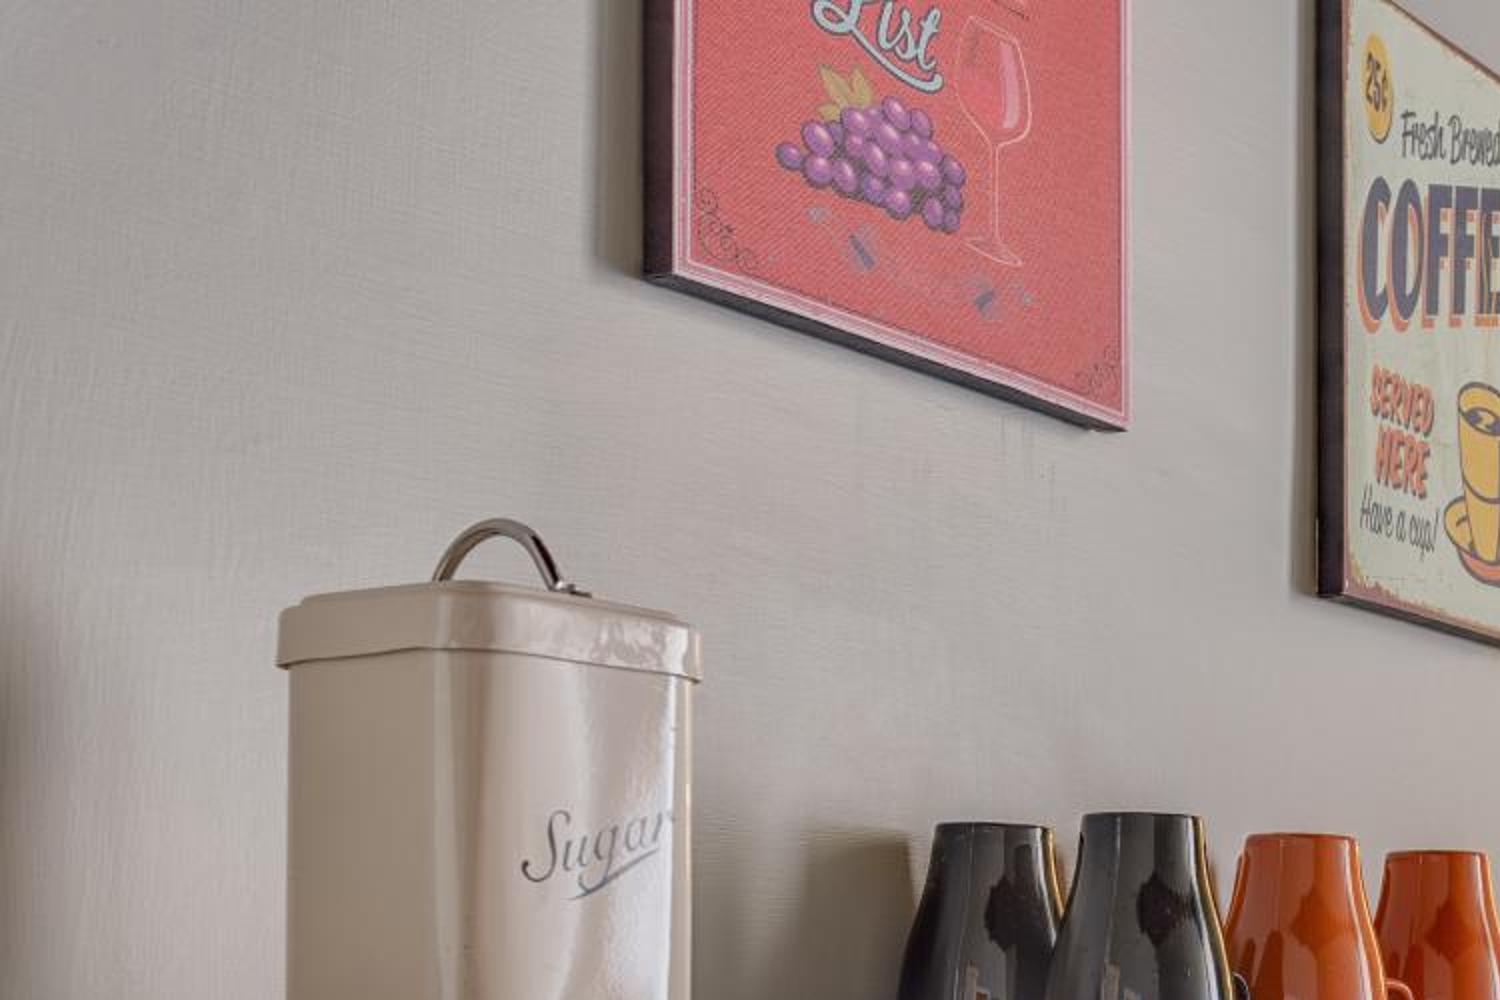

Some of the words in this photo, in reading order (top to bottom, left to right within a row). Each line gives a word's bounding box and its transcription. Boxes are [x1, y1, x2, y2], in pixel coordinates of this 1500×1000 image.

[1400, 109, 1447, 161] Fresh
[1370, 363, 1435, 437] SERVED
[1374, 423, 1431, 500] HERE
[1359, 482, 1393, 538] Have
[1396, 511, 1407, 543] a
[1409, 508, 1439, 562] cup!
[521, 809, 675, 900] Sugar
